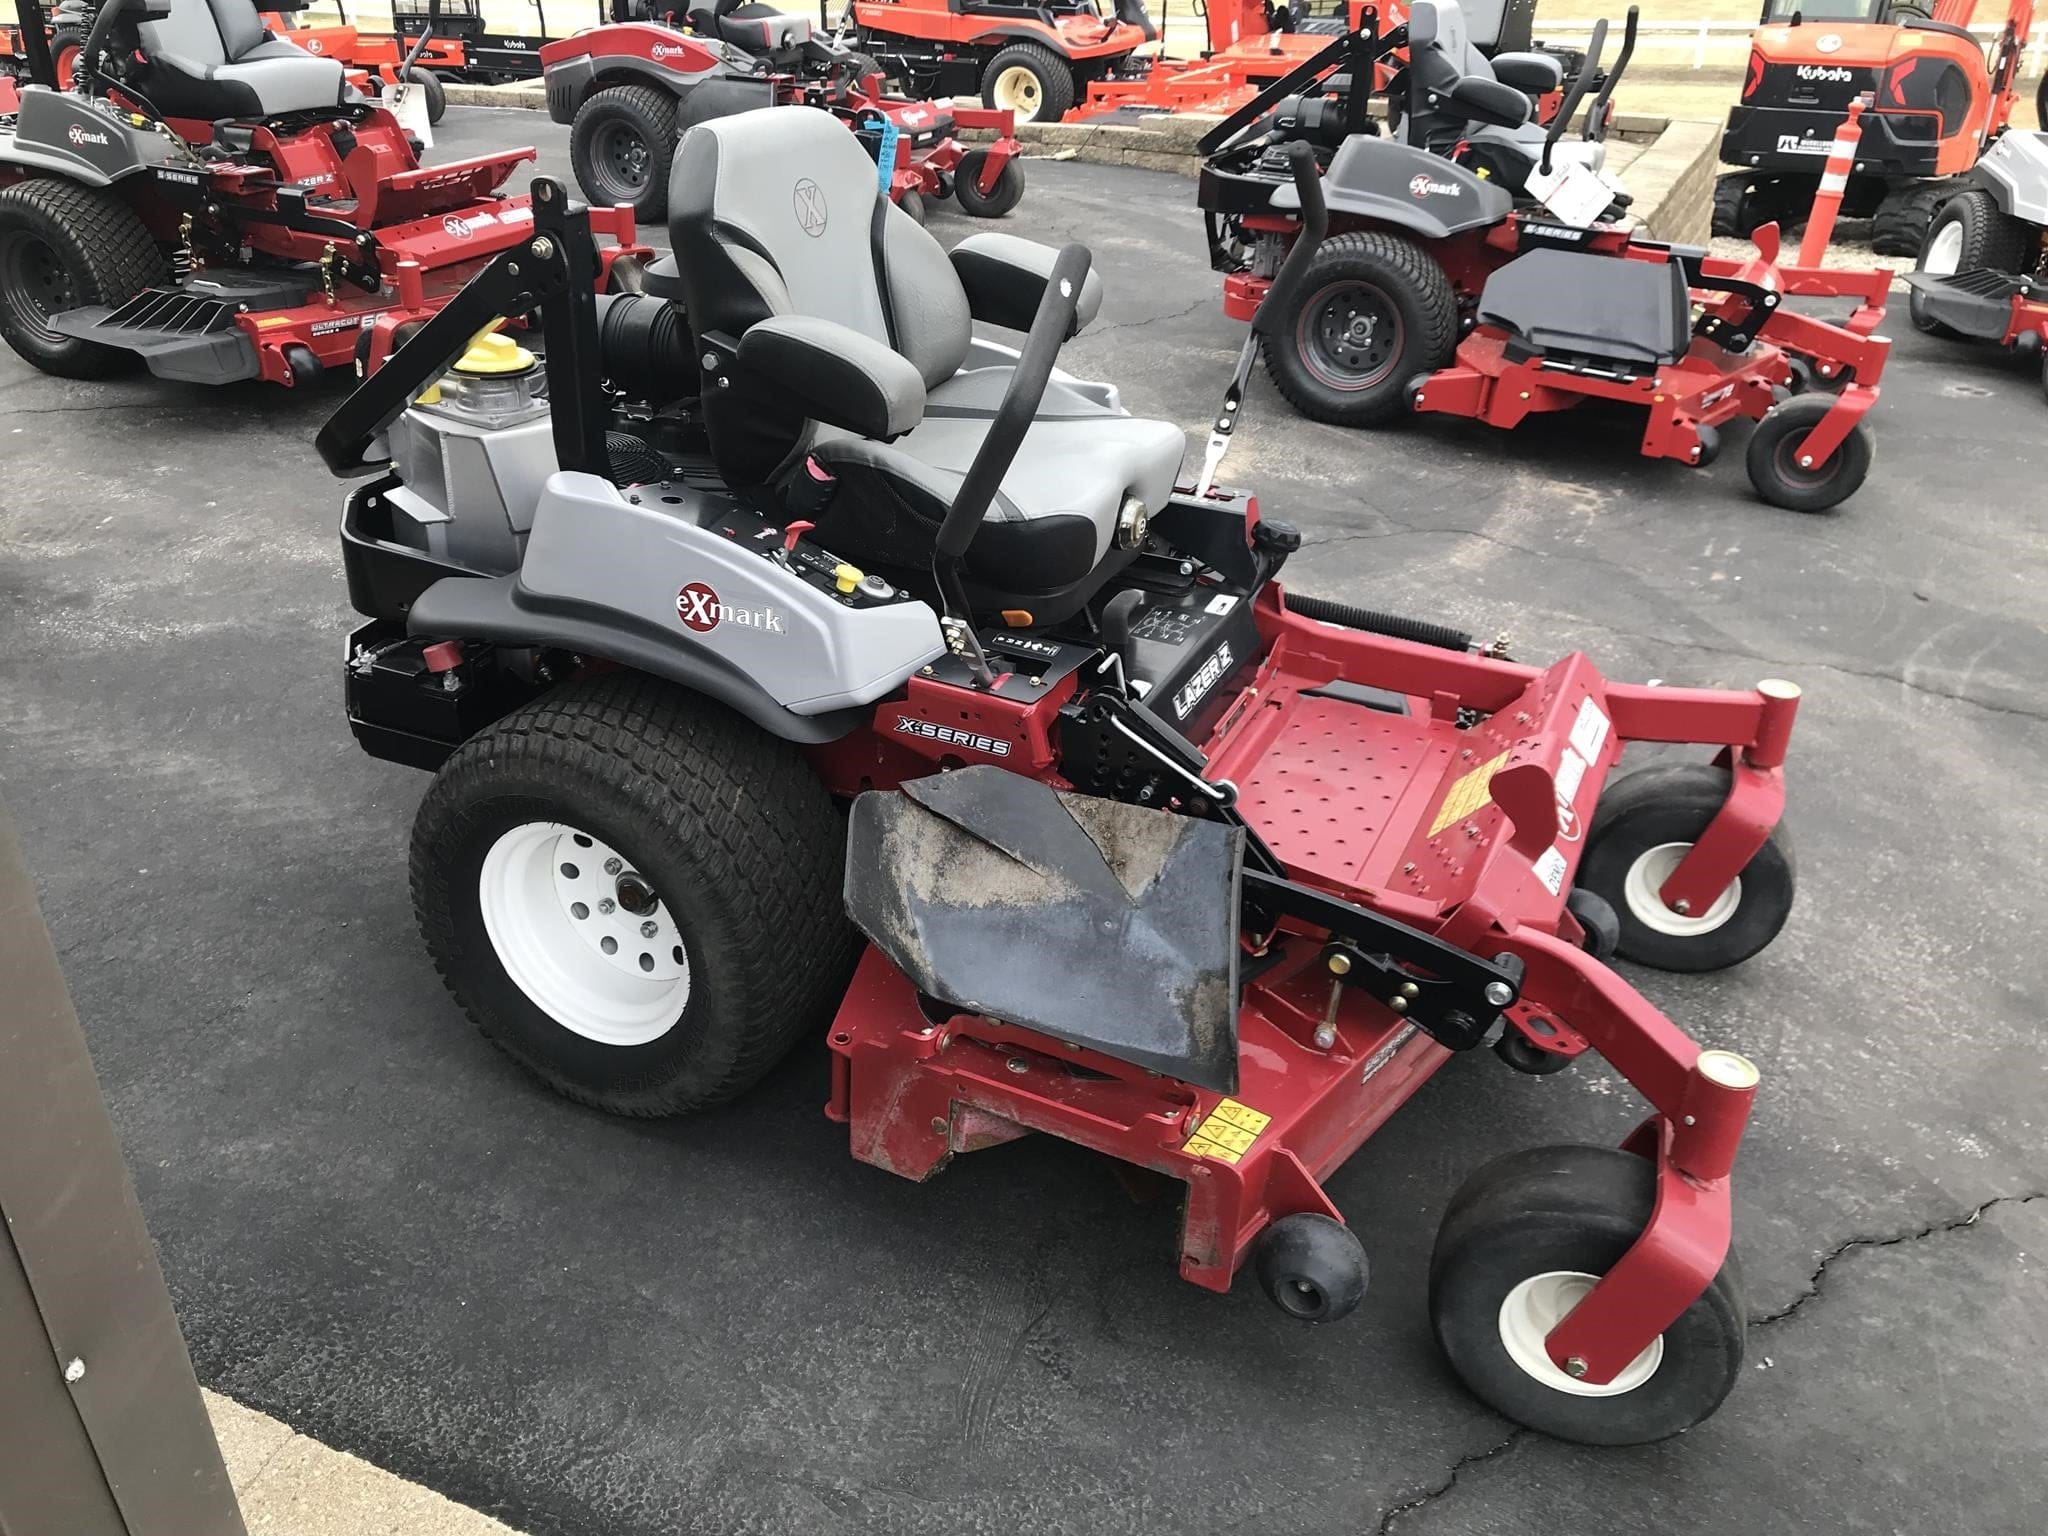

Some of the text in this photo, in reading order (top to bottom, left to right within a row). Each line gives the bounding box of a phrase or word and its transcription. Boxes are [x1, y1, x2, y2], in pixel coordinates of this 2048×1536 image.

[504, 39, 526, 49] Kubota
[1796, 65, 1853, 82] Kubota
[69, 127, 109, 147] eXmark
[1409, 174, 1461, 197] eXmark
[311, 315, 360, 332] ULTRACUT
[675, 588, 782, 632] eXmark
[1173, 640, 1233, 720] LAZER Z
[896, 716, 1011, 756] X-SERIES
